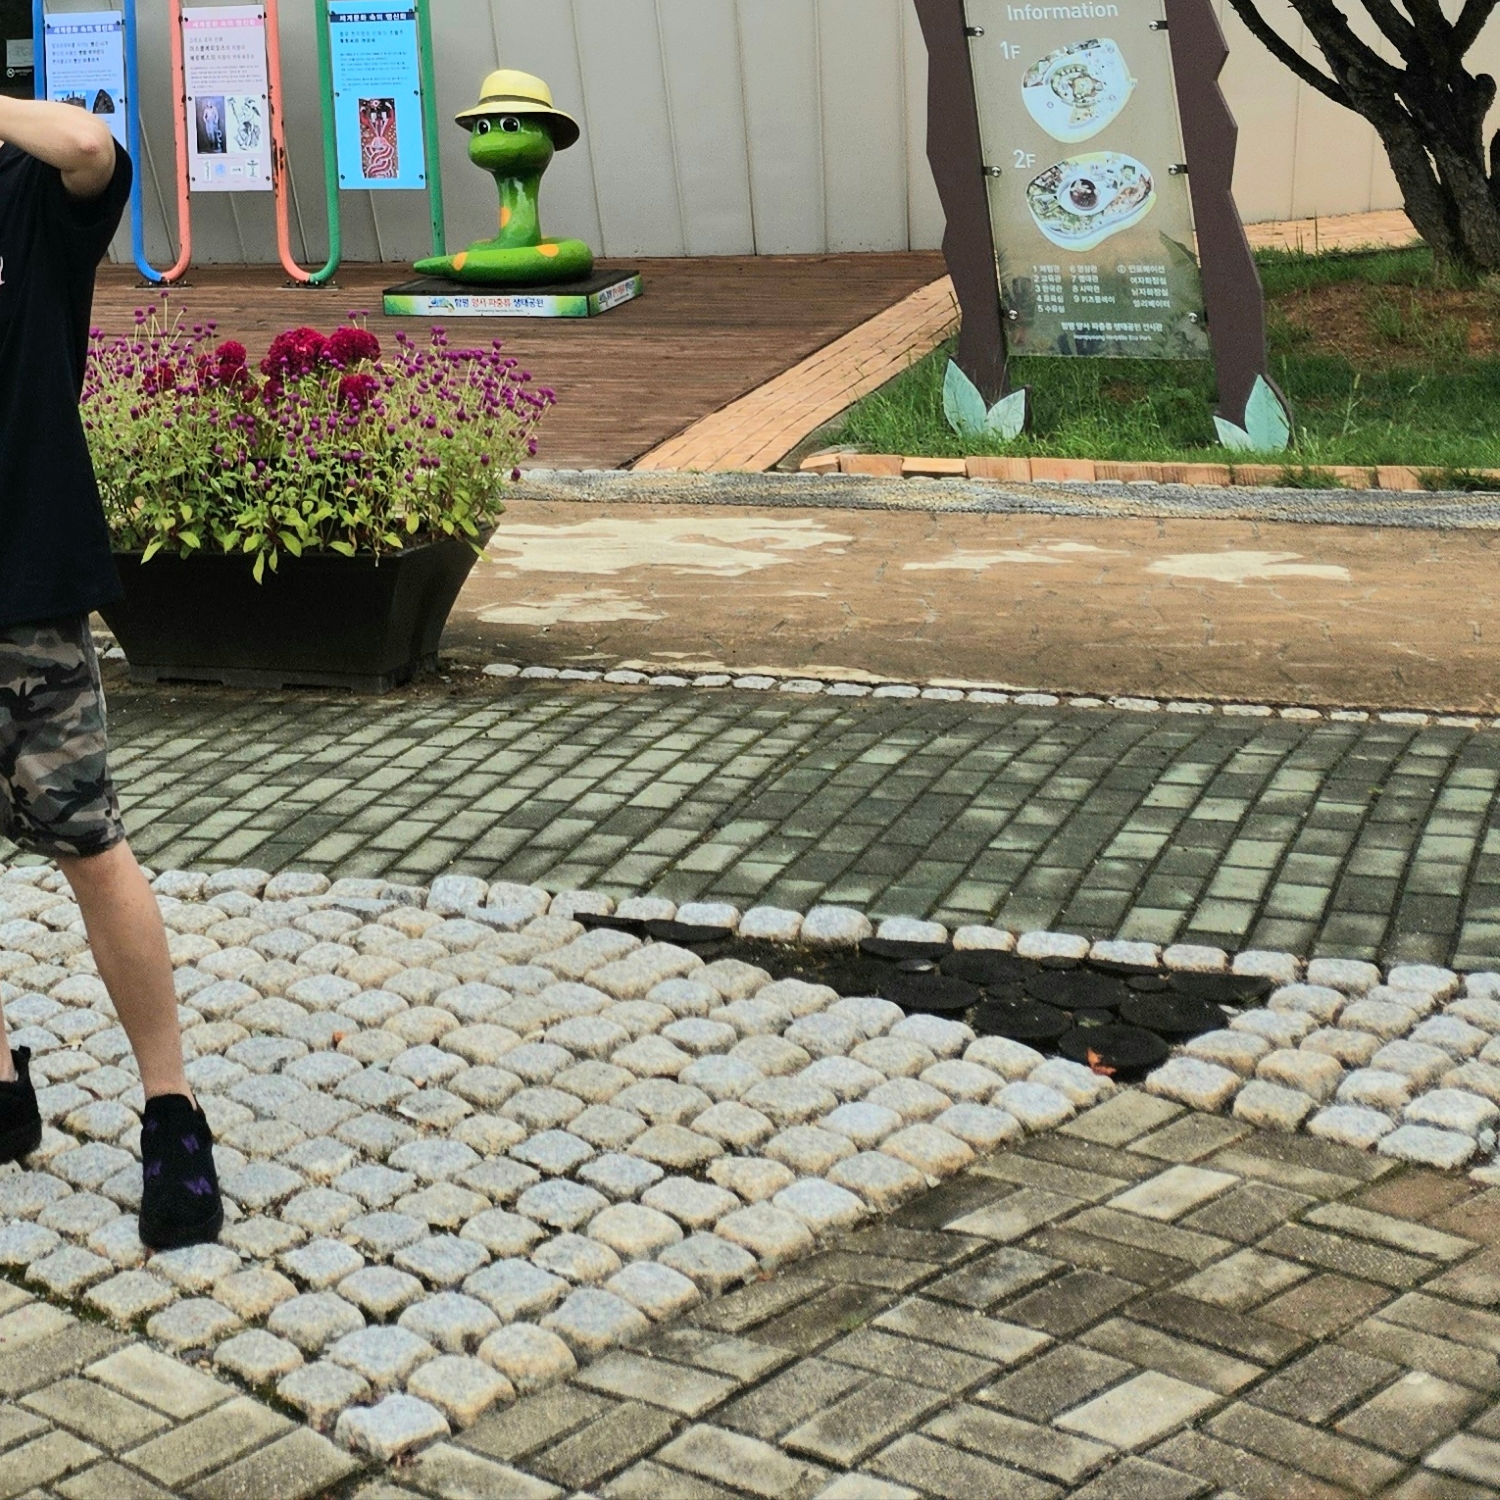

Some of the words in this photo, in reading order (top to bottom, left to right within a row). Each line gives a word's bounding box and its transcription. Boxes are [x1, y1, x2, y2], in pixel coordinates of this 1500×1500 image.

[1007, 2, 1119, 21] Information
[1000, 41, 1021, 60] 1F
[1013, 149, 1036, 169] 2F
[513, 298, 544, 308] 생태공원
